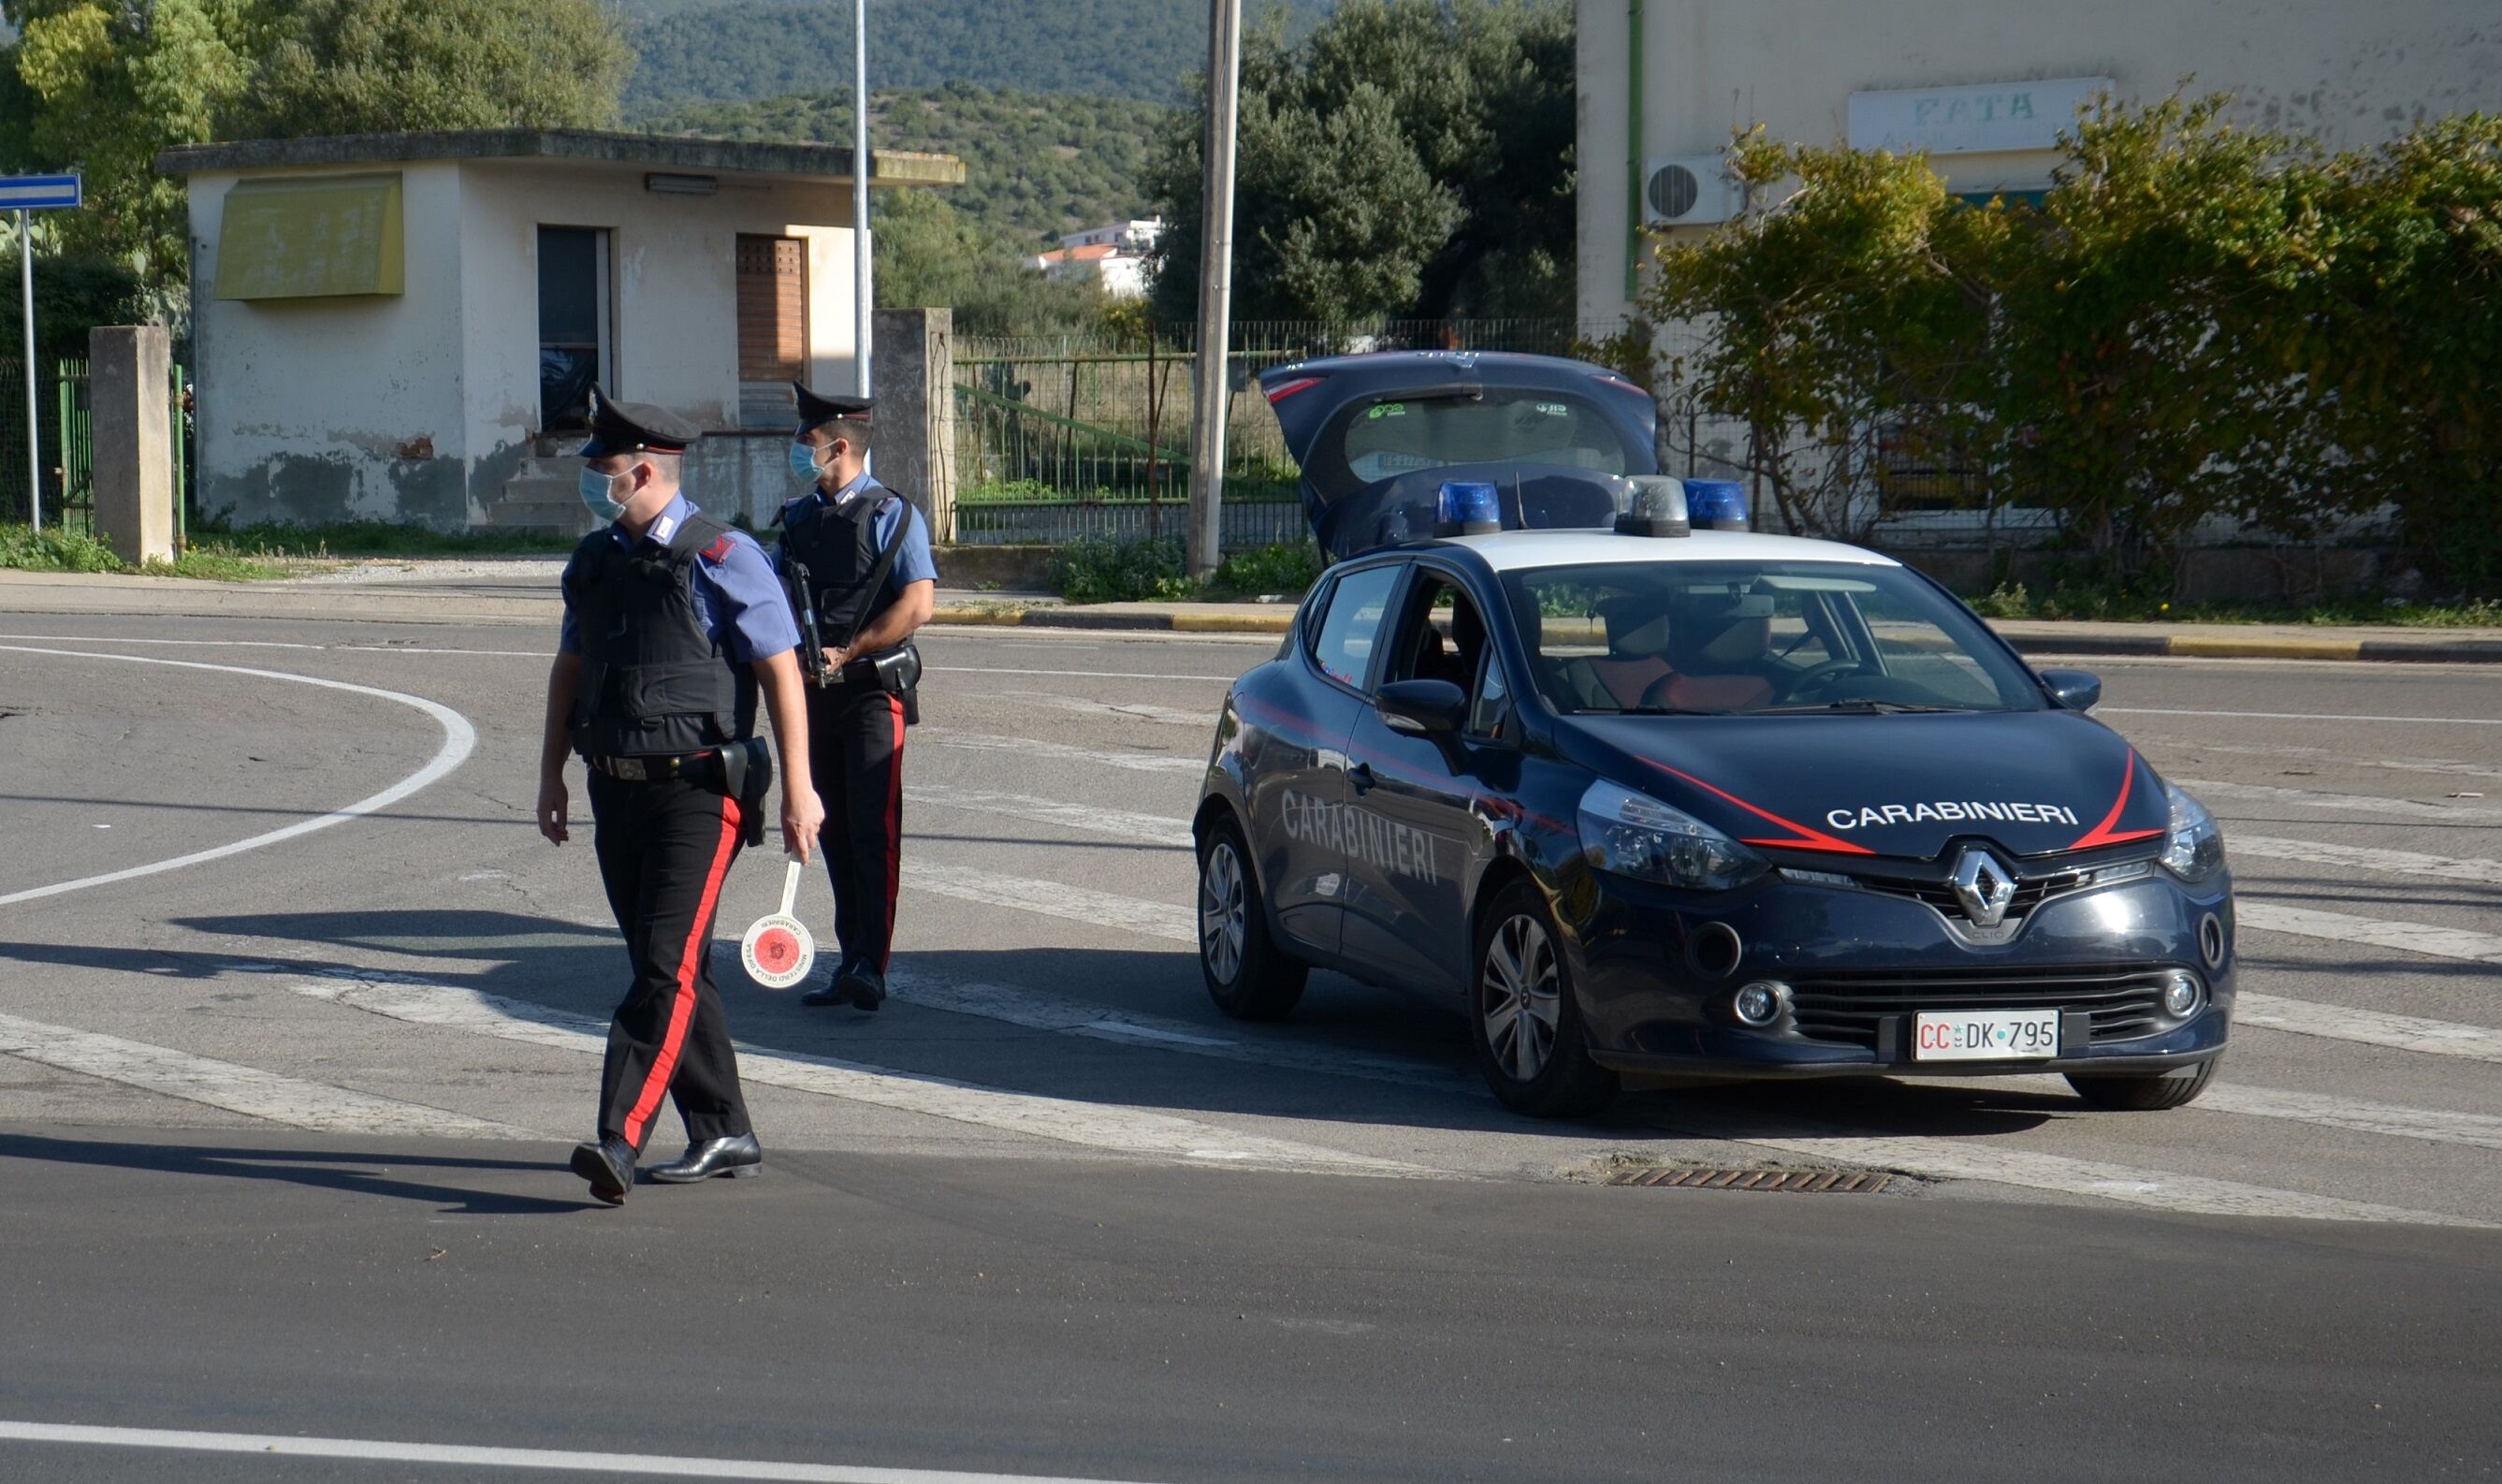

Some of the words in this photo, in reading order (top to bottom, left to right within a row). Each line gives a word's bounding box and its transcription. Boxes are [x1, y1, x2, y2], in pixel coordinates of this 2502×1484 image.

[1826, 801, 2079, 830] CARABINIERI
[1282, 788, 1437, 886] CARABINIERI
[1920, 1022, 1951, 1049] CC
[1966, 1021, 1995, 1048] DK
[2008, 1020, 2055, 1048] 795
